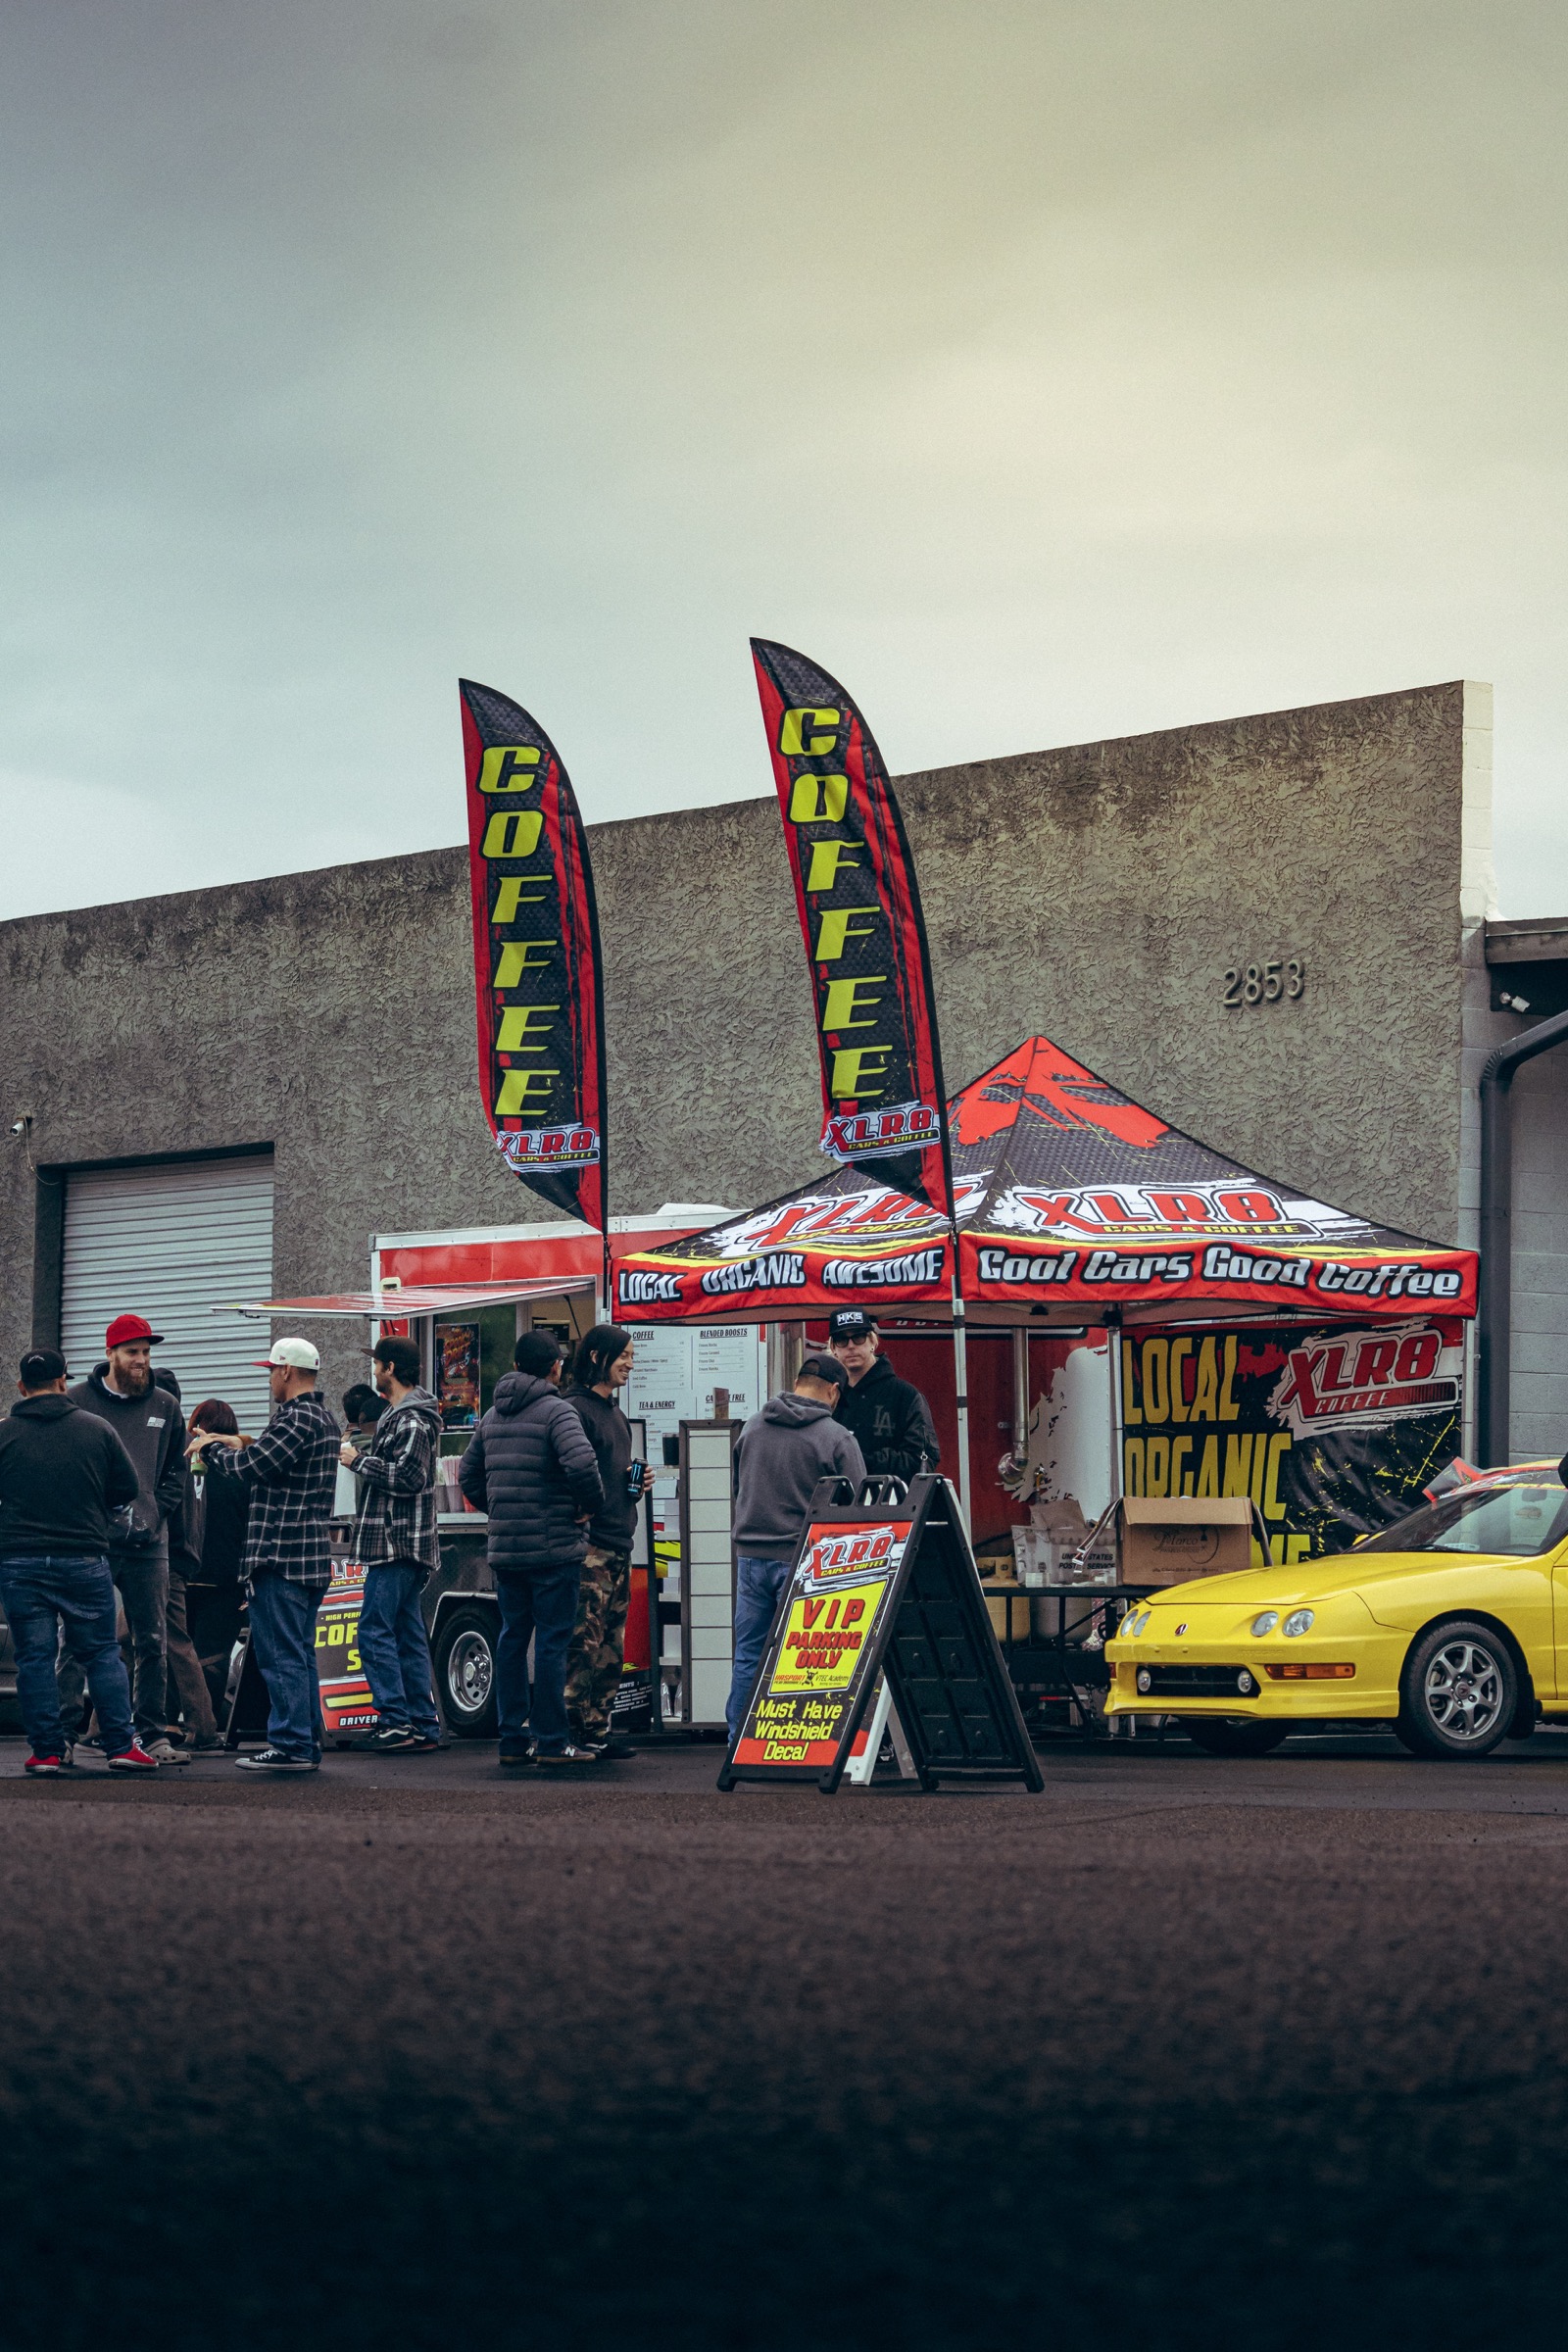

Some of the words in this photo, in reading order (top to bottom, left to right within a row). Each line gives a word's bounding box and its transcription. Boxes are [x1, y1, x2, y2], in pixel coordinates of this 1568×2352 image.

[780, 708, 893, 1099] COFFEE
[480, 747, 561, 1115] COFFEE
[1223, 959, 1304, 1007] 2853
[826, 1109, 932, 1152] XLR8
[848, 1141, 879, 1150] CARS
[894, 1132, 933, 1143] COFFEE
[553, 1152, 592, 1160] COFFEE
[1021, 1191, 1278, 1229] XLR8
[857, 1219, 933, 1233] COFFEE
[1103, 1224, 1173, 1233] CARS
[1209, 1224, 1300, 1233] COFFEE
[618, 1273, 681, 1302] LOCAL
[702, 1254, 806, 1293] ORGANIC
[823, 1250, 943, 1285] AWESOME
[980, 1249, 1074, 1281] Cool
[1086, 1251, 1191, 1282] Cars
[1205, 1247, 1307, 1285] Good
[1318, 1262, 1460, 1297] Coffee
[837, 1312, 863, 1323] HKS
[725, 1328, 748, 1337] BOOSTS
[1122, 1335, 1240, 1425] LOCAL
[1282, 1334, 1441, 1418] XLR8
[1314, 1391, 1391, 1414] COFFEE
[805, 1536, 892, 1579] XLR8
[820, 1566, 844, 1577] CARS
[854, 1560, 884, 1571] COFFEE
[803, 1599, 865, 1629] VIP
[786, 1631, 862, 1650] PARKING
[795, 1651, 843, 1669] ONLY
[756, 1699, 797, 1718] Must
[802, 1700, 843, 1719] Have
[755, 1720, 834, 1740] Windshield
[763, 1740, 809, 1760] Decal
